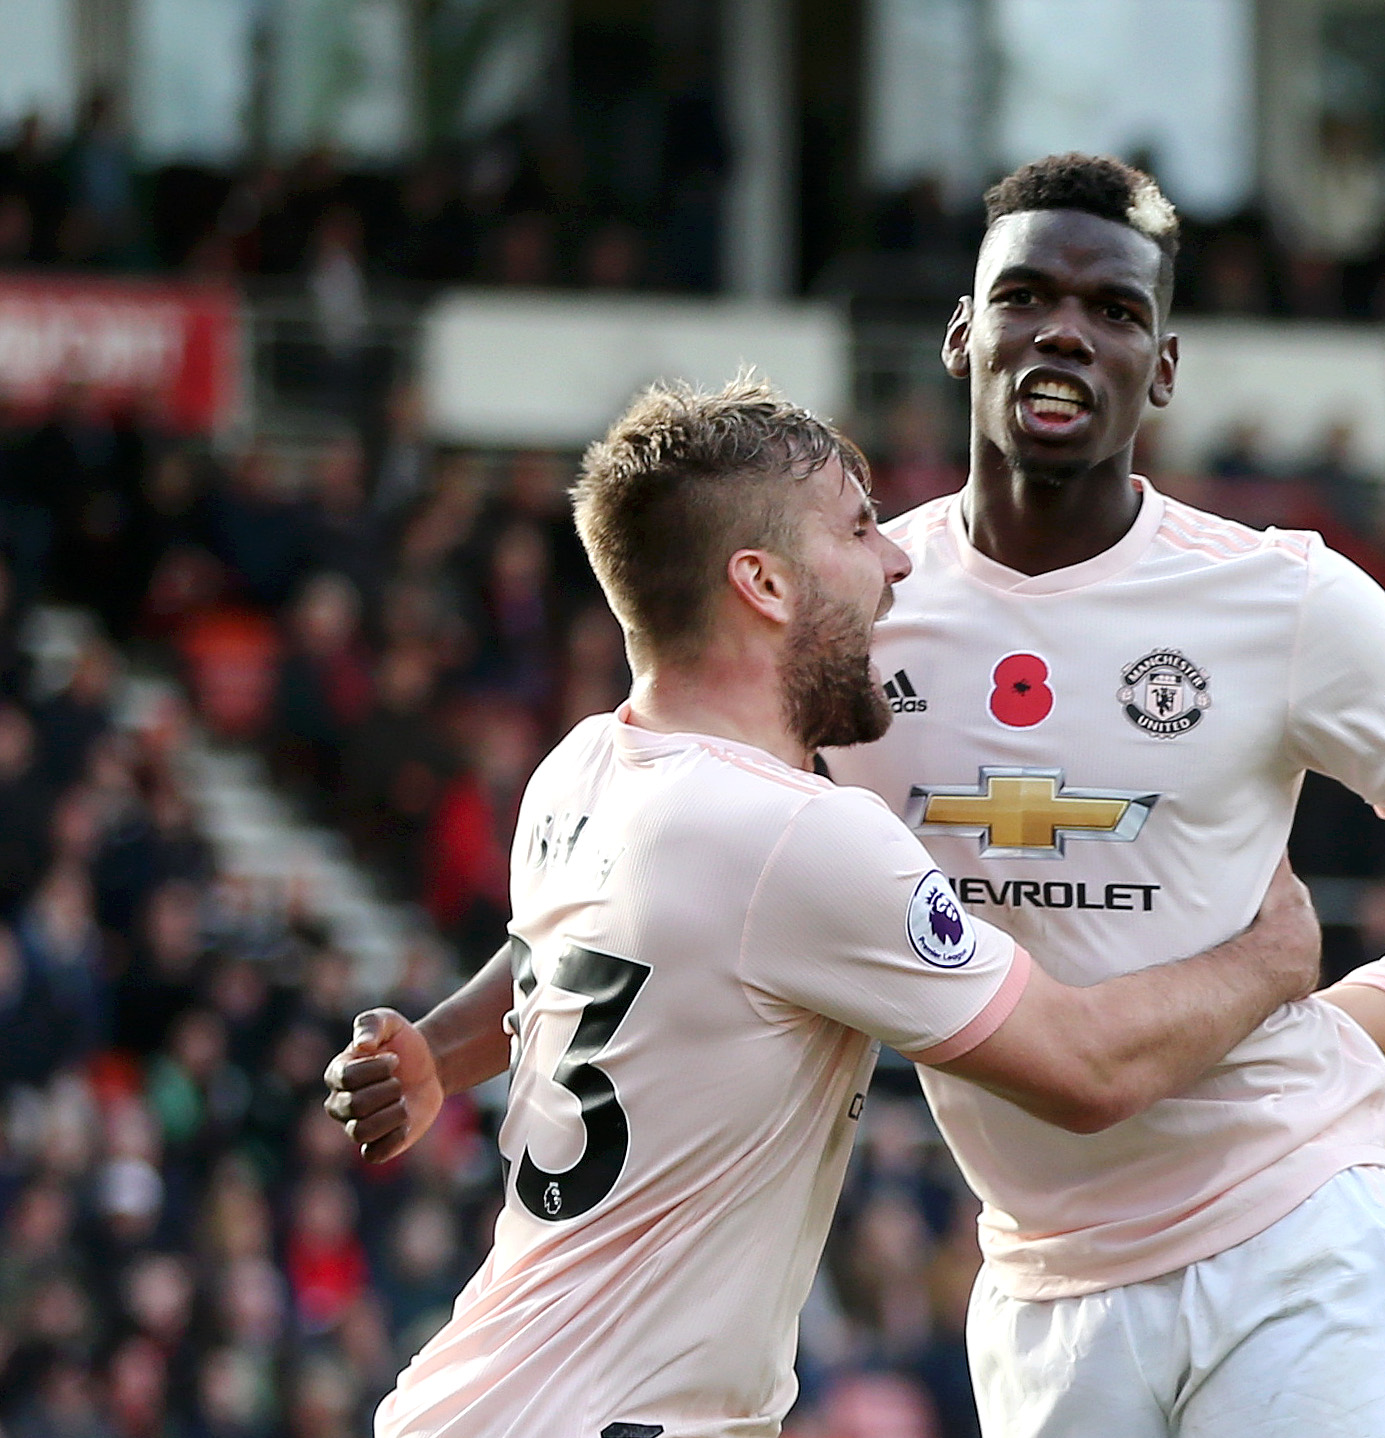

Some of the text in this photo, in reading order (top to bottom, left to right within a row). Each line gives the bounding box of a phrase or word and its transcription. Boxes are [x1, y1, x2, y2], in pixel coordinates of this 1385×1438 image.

[1127, 654, 1205, 687] MANCHESTER
[890, 697, 928, 714] das
[1137, 714, 1191, 732] UNITED
[949, 877, 1161, 912] EVROLET
[501, 932, 654, 1225] 3
